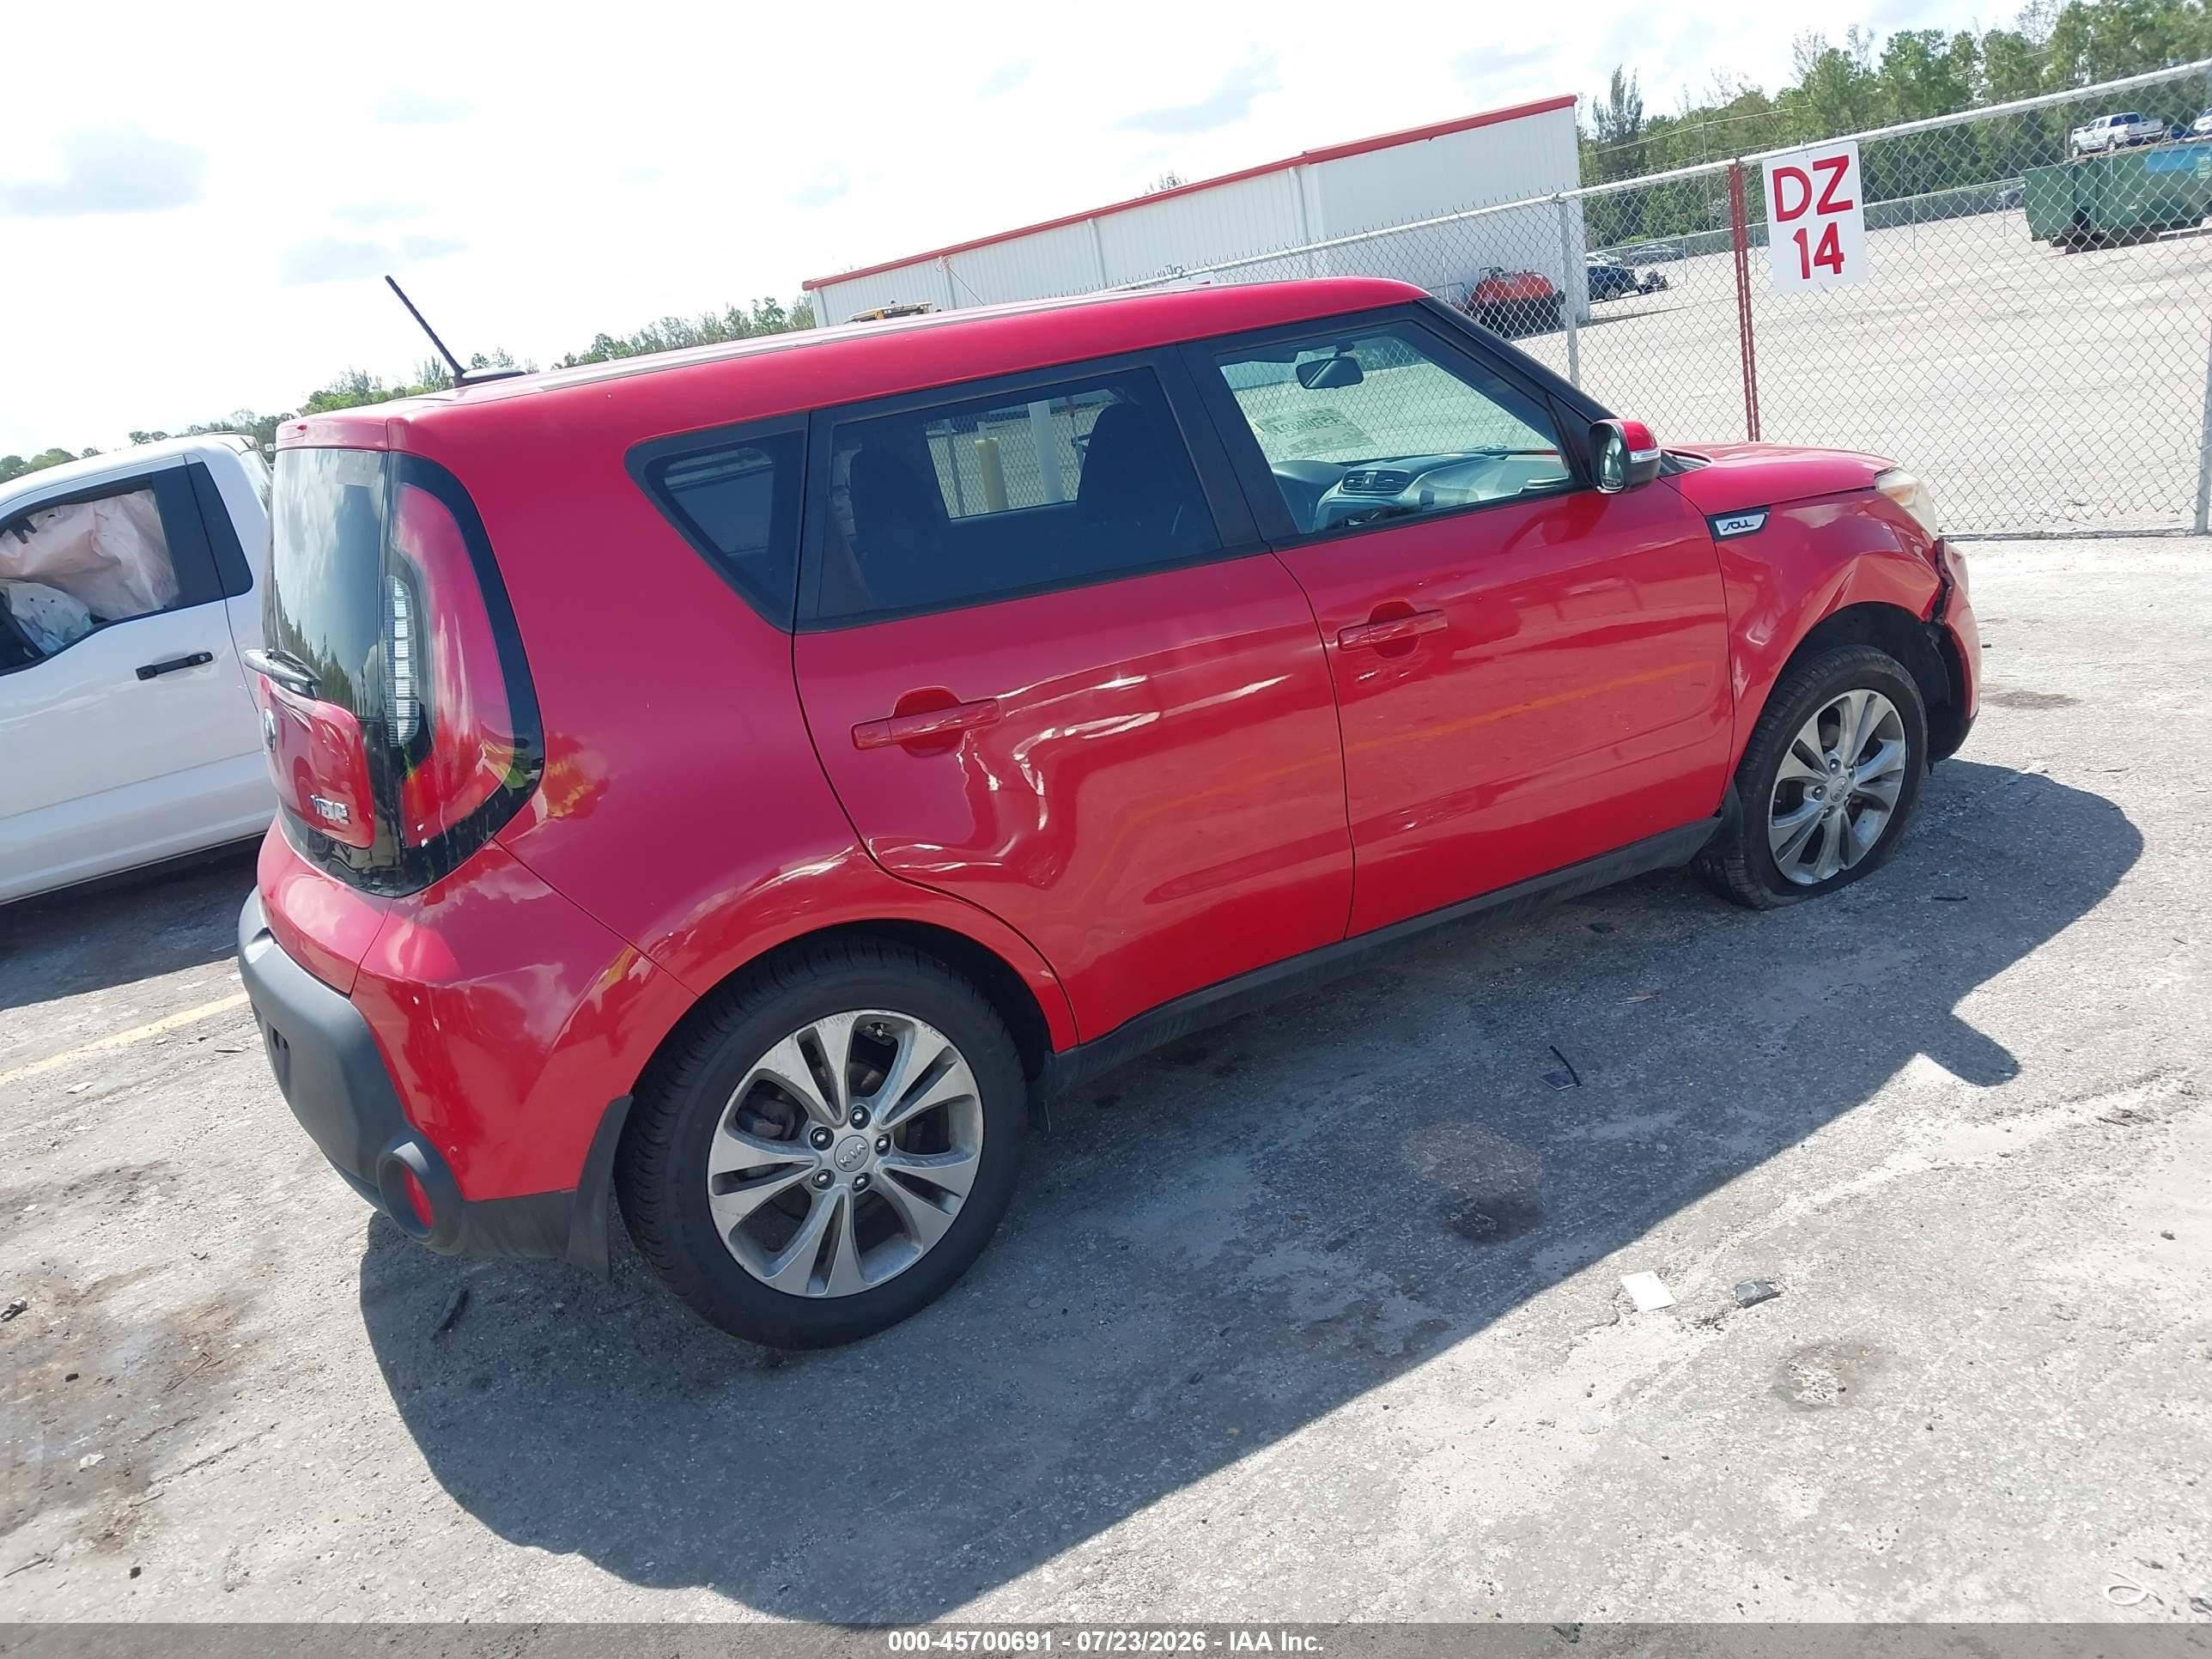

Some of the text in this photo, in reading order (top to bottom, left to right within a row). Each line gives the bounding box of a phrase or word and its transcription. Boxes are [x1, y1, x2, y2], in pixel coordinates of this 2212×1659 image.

[1772, 155, 1853, 221] DZ
[1792, 222, 1844, 279] 14
[839, 1144, 866, 1167] KIA
